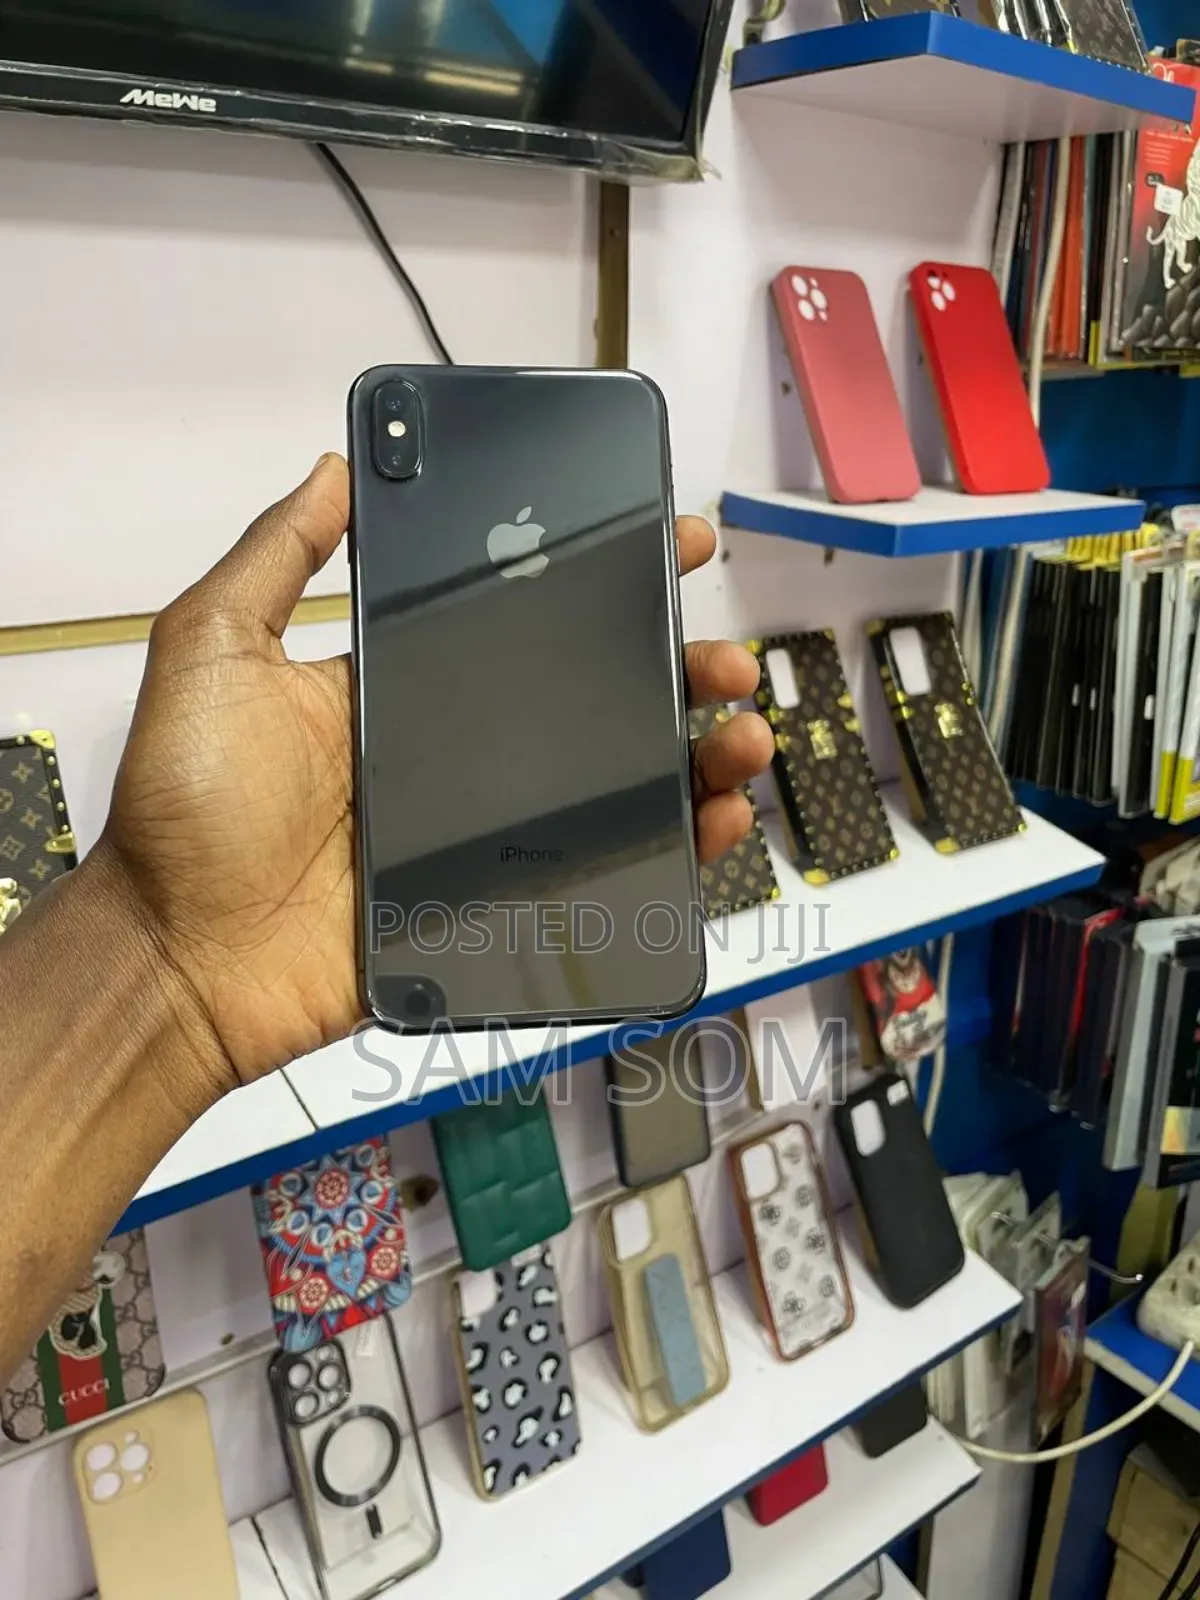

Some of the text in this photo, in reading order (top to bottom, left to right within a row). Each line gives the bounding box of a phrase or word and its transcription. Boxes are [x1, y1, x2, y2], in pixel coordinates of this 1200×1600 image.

[120, 88, 216, 112] MeWe
[500, 846, 563, 862] iPhone
[58, 1378, 109, 1405] GUCCI
